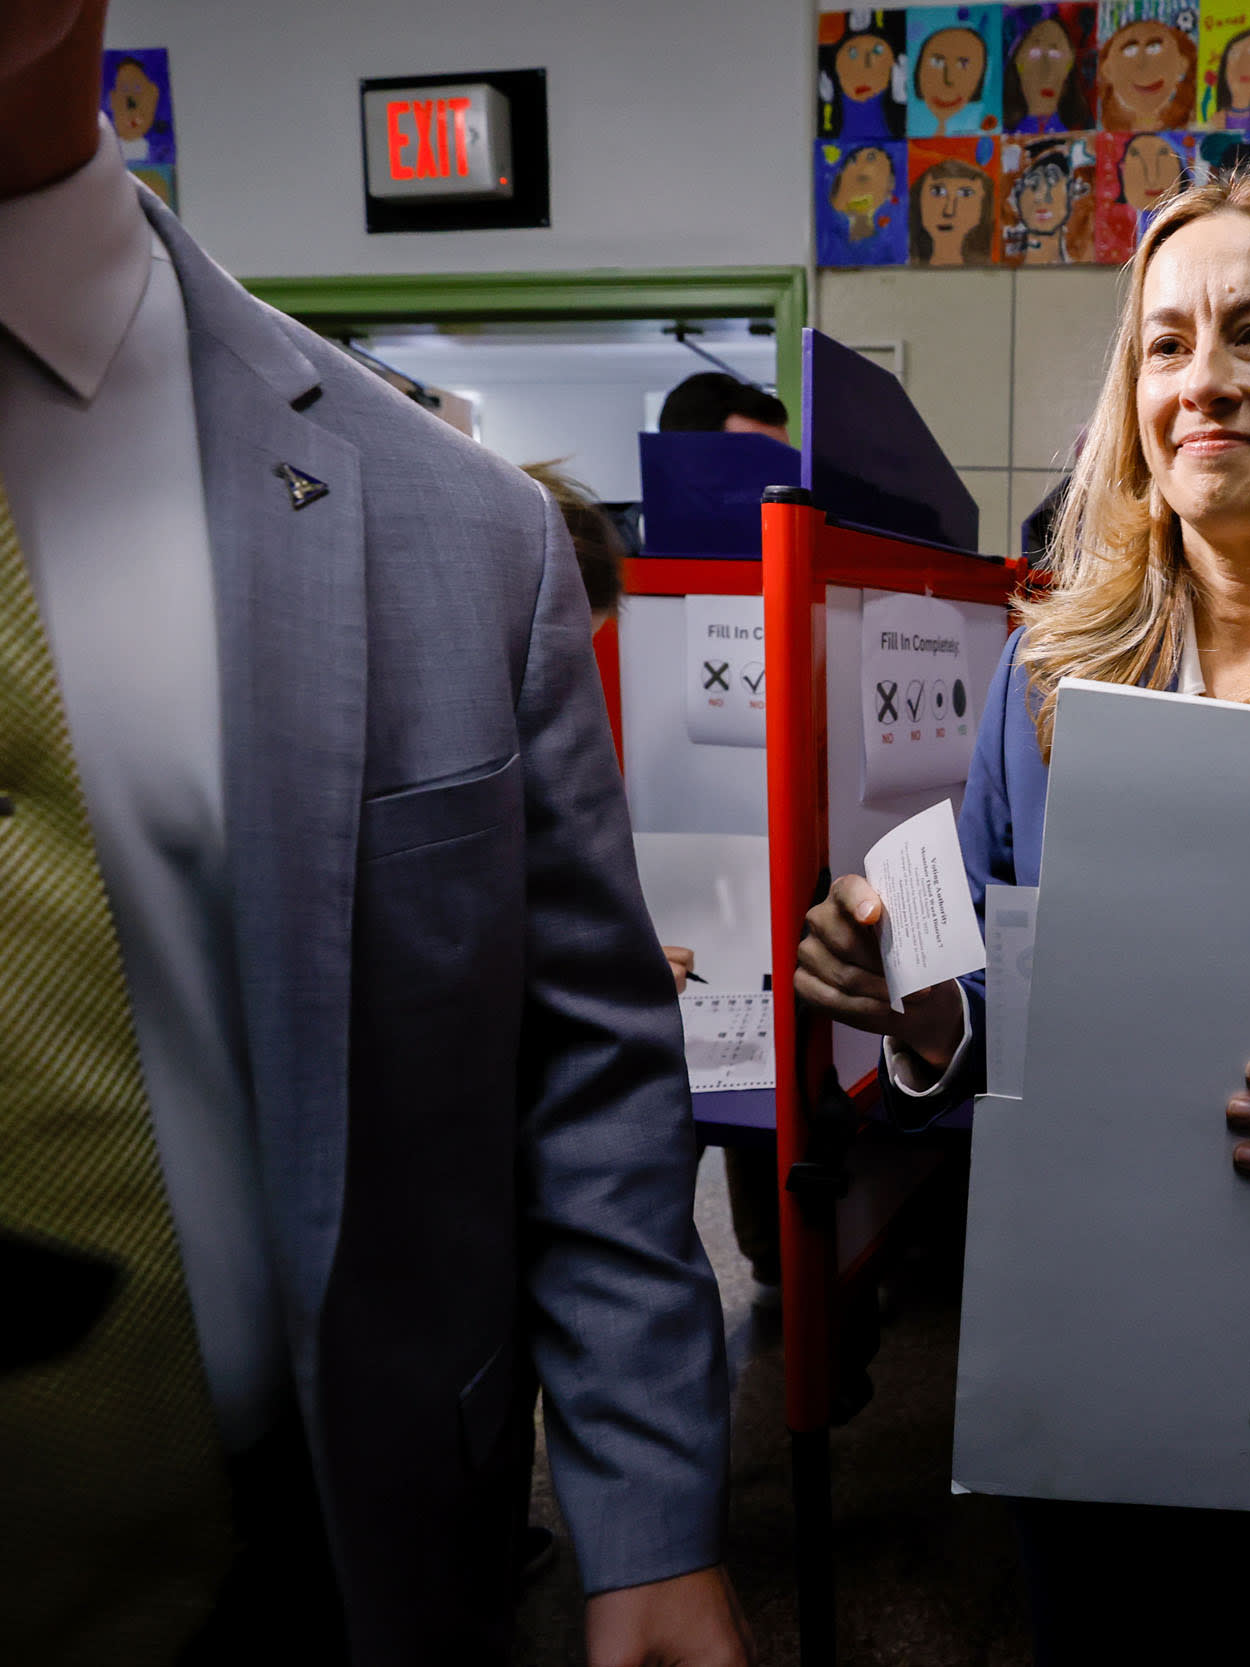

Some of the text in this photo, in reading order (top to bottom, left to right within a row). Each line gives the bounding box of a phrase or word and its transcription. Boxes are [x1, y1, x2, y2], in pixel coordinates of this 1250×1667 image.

[387, 97, 471, 180] EXIT
[708, 624, 730, 639] Fill
[734, 626, 748, 640] In
[881, 632, 898, 650] Fill
[901, 632, 911, 651] In
